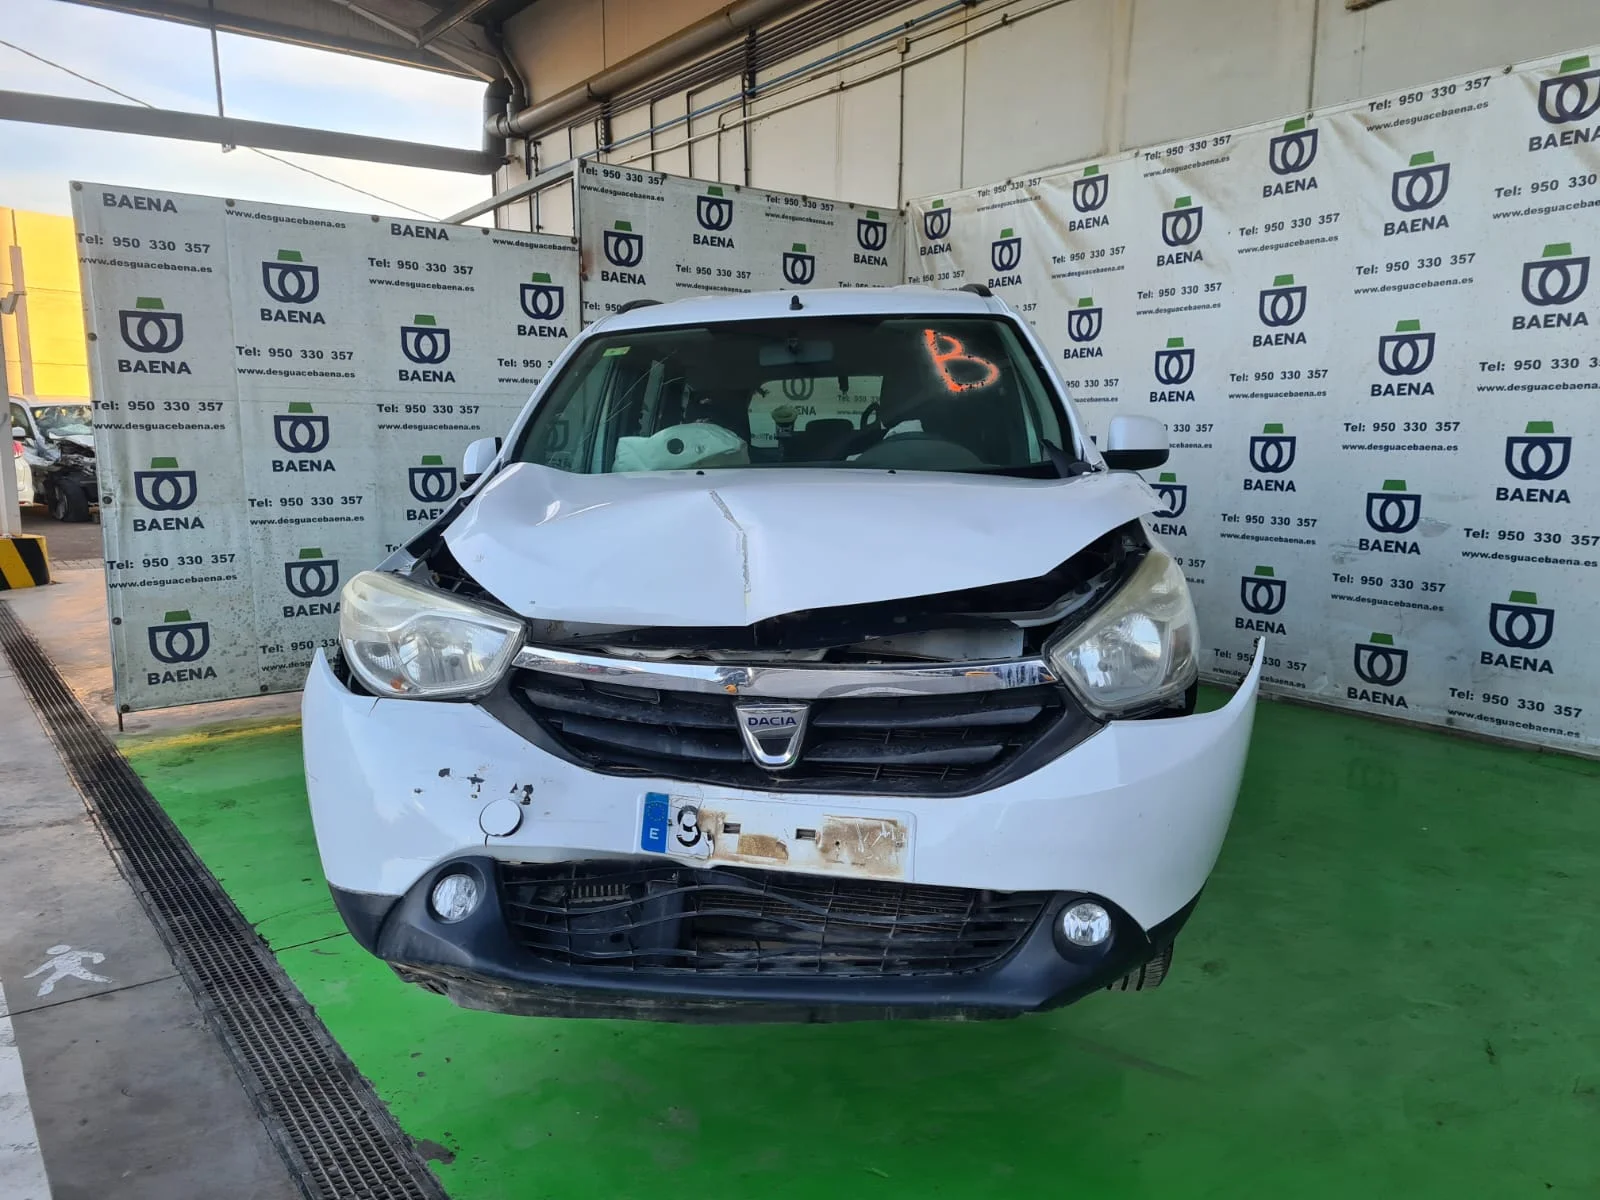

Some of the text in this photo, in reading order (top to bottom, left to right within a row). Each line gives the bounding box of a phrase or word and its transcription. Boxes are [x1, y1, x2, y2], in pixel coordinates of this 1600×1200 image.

[1368, 76, 1491, 112] Tel: 950 330 357
[1366, 101, 1488, 132] www.desguacebaena.es
[1145, 135, 1232, 161] Tel: 950 330 357
[603, 170, 665, 185] 950 330 357
[581, 185, 665, 202] www.desguacebaena.es
[1263, 177, 1318, 198] BAENA
[1495, 174, 1597, 198] Tel: 950 330
[103, 193, 177, 213] BAENA
[784, 198, 834, 211] 950 357
[225, 208, 346, 229] www.desguacebaena.es
[1069, 215, 1109, 231] BAENA
[1239, 213, 1340, 236] Tel: 950 330 357
[1384, 215, 1449, 236] BAENA
[391, 223, 449, 241] BAENA
[78, 233, 210, 254] Tel: 950 330 357
[693, 234, 735, 248] BAENA
[1238, 235, 1338, 254] www.desguacebaena.es
[920, 244, 952, 255] BAENA
[1052, 246, 1125, 264] Tel: 950 330 357
[78, 256, 212, 272] www.desguacebaena.es
[854, 254, 888, 267] BAENA
[1157, 250, 1203, 266] BAENA
[1356, 253, 1476, 276] Tel: 950 330 357
[368, 258, 473, 275] Tel: 950 330 357
[676, 264, 751, 279] Tel: 950 330 357
[369, 278, 474, 292] www.desguacebaena.es
[601, 271, 646, 285] BAENA
[988, 275, 1022, 288] BAENA
[1354, 276, 1473, 295] www.desguacebaena.es
[1137, 283, 1222, 299] Tel: 950 330 357
[583, 302, 600, 310] Tel:
[260, 309, 326, 324] BAENA
[1512, 312, 1588, 330] BAENA
[517, 325, 568, 338] BAENA
[1253, 332, 1307, 347] BAENA
[236, 346, 353, 360] Tel: 950 330 357
[924, 329, 998, 392] B
[1064, 347, 1103, 359] BAENA
[118, 360, 192, 374] BAENA
[497, 359, 517, 367] Tel:
[523, 360, 541, 368] 950
[1479, 362, 1505, 372] Tel:
[1514, 360, 1541, 370] 950
[1551, 358, 1579, 369] 330
[237, 367, 355, 378] www.desguacebaena.es
[399, 370, 455, 382] BAENA
[1229, 370, 1328, 382] Tel: 950 330 357
[1104, 379, 1119, 387] 357
[1371, 382, 1434, 396] BAENA
[1150, 391, 1195, 402] BAENA
[1228, 390, 1327, 400] www.desguacebaena.es
[92, 400, 223, 411] Tel: 950 330 357
[433, 405, 479, 414] 330 357
[94, 422, 225, 431] www.desguacebaena.es
[378, 423, 480, 431] www.desguacebaena.es
[1173, 424, 1190, 432] 330
[1196, 424, 1213, 432] 357
[1343, 422, 1460, 432] Tel: 950 330 357
[1342, 443, 1458, 452] www.desguacebaena.es
[272, 460, 336, 472] BAENA
[1243, 479, 1296, 492] BAENA
[248, 496, 363, 507] Tel: 950 330 357
[1496, 487, 1570, 503] BAENA
[133, 517, 204, 532] BAENA
[250, 515, 364, 526] www.desguacebaena.es
[1221, 513, 1317, 528] Tel: 950 330 357
[1220, 532, 1316, 545] www.desguacebaena.es
[1464, 528, 1600, 546] Tel: 950 330 357
[1359, 539, 1421, 555] BAENA
[1188, 559, 1206, 568] 357
[1462, 550, 1597, 567] www.desguacebaena.es
[109, 574, 237, 589] www.desguacebaena.es
[1332, 573, 1446, 592] Tel: 950 330 357
[1331, 593, 1444, 612] www.desguacebaena.es
[1235, 618, 1286, 635] BAENA
[260, 641, 313, 654] Tel: 950
[1214, 648, 1307, 671] Tel: 357
[1480, 651, 1554, 674] BAENA
[147, 666, 217, 685] BAENA
[1347, 687, 1408, 709] BAENA
[1449, 687, 1582, 718] Tel: 950 330 357
[748, 717, 796, 726] DACIA
[1448, 708, 1581, 739] www.desguacebaena.es
[650, 828, 659, 839] E
[677, 806, 701, 847] 9
